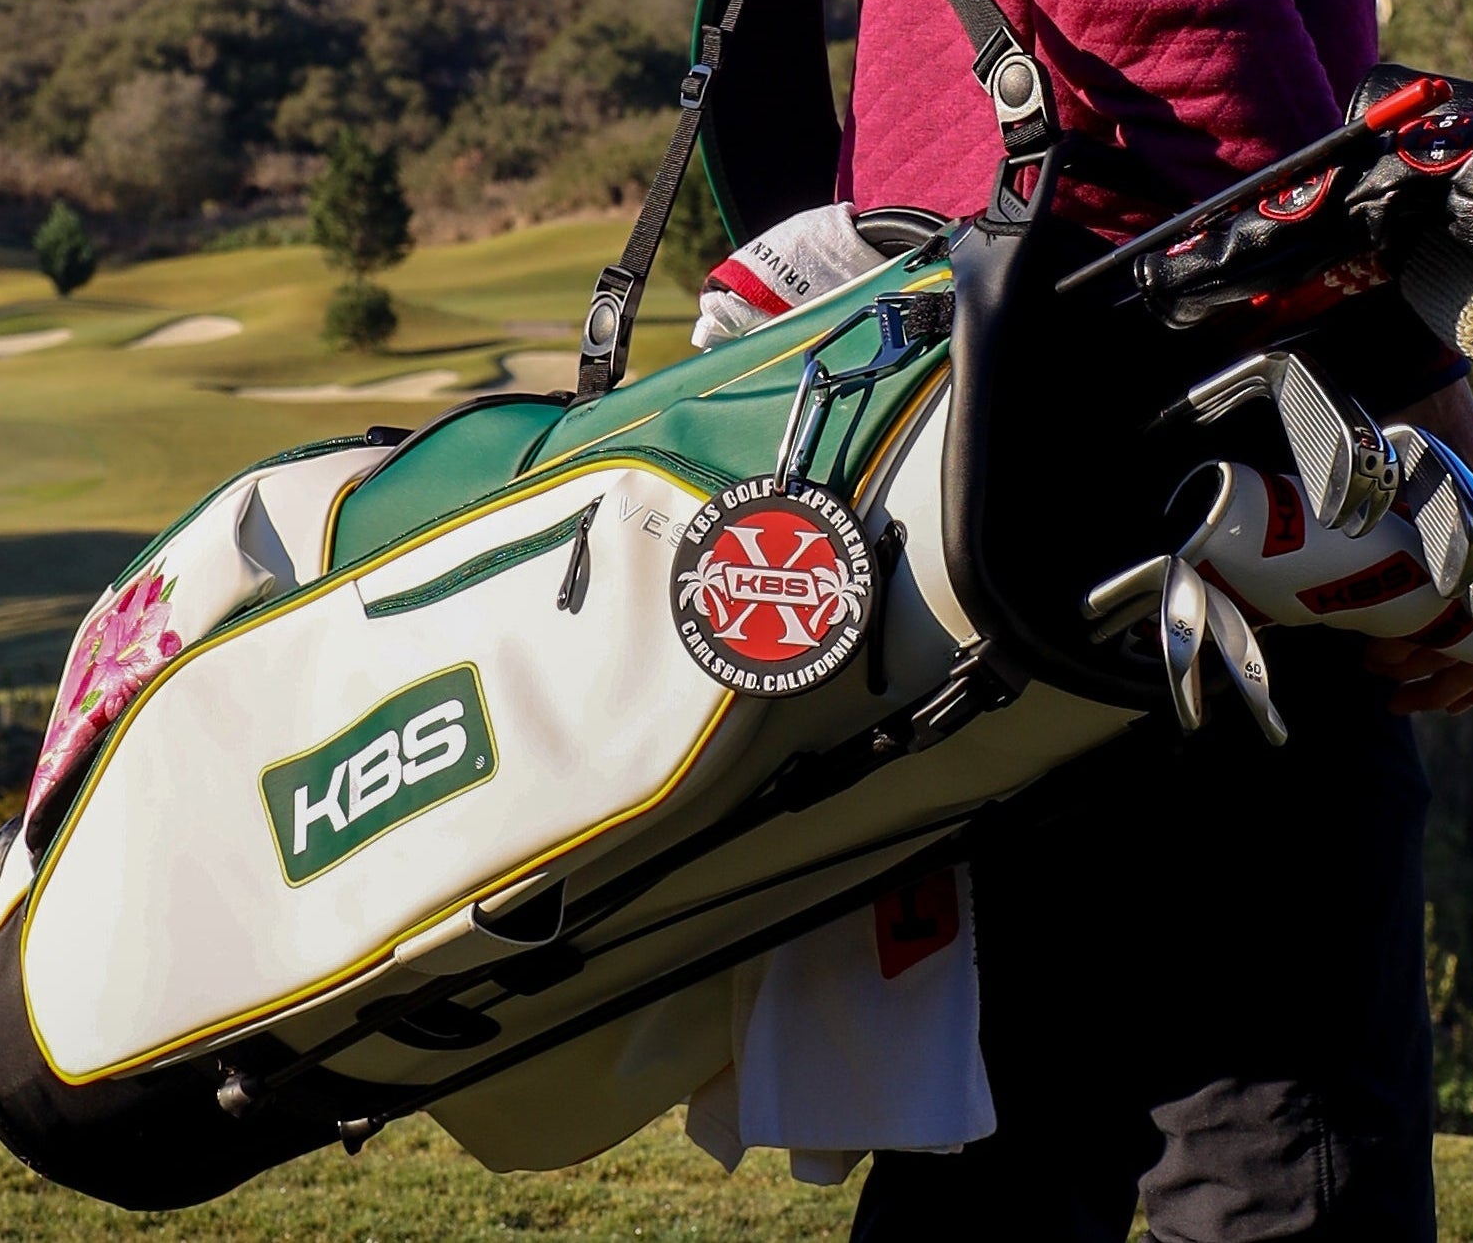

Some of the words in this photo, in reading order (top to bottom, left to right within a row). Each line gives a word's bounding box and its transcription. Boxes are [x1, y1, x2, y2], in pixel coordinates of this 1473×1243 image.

[685, 504, 724, 545] KBS
[721, 477, 776, 510] GOLF
[735, 573, 809, 597] KBS
[1174, 619, 1195, 637] 56
[762, 625, 862, 692] CALIFORNIA
[1244, 660, 1262, 675] 60
[292, 698, 468, 856] KBS
